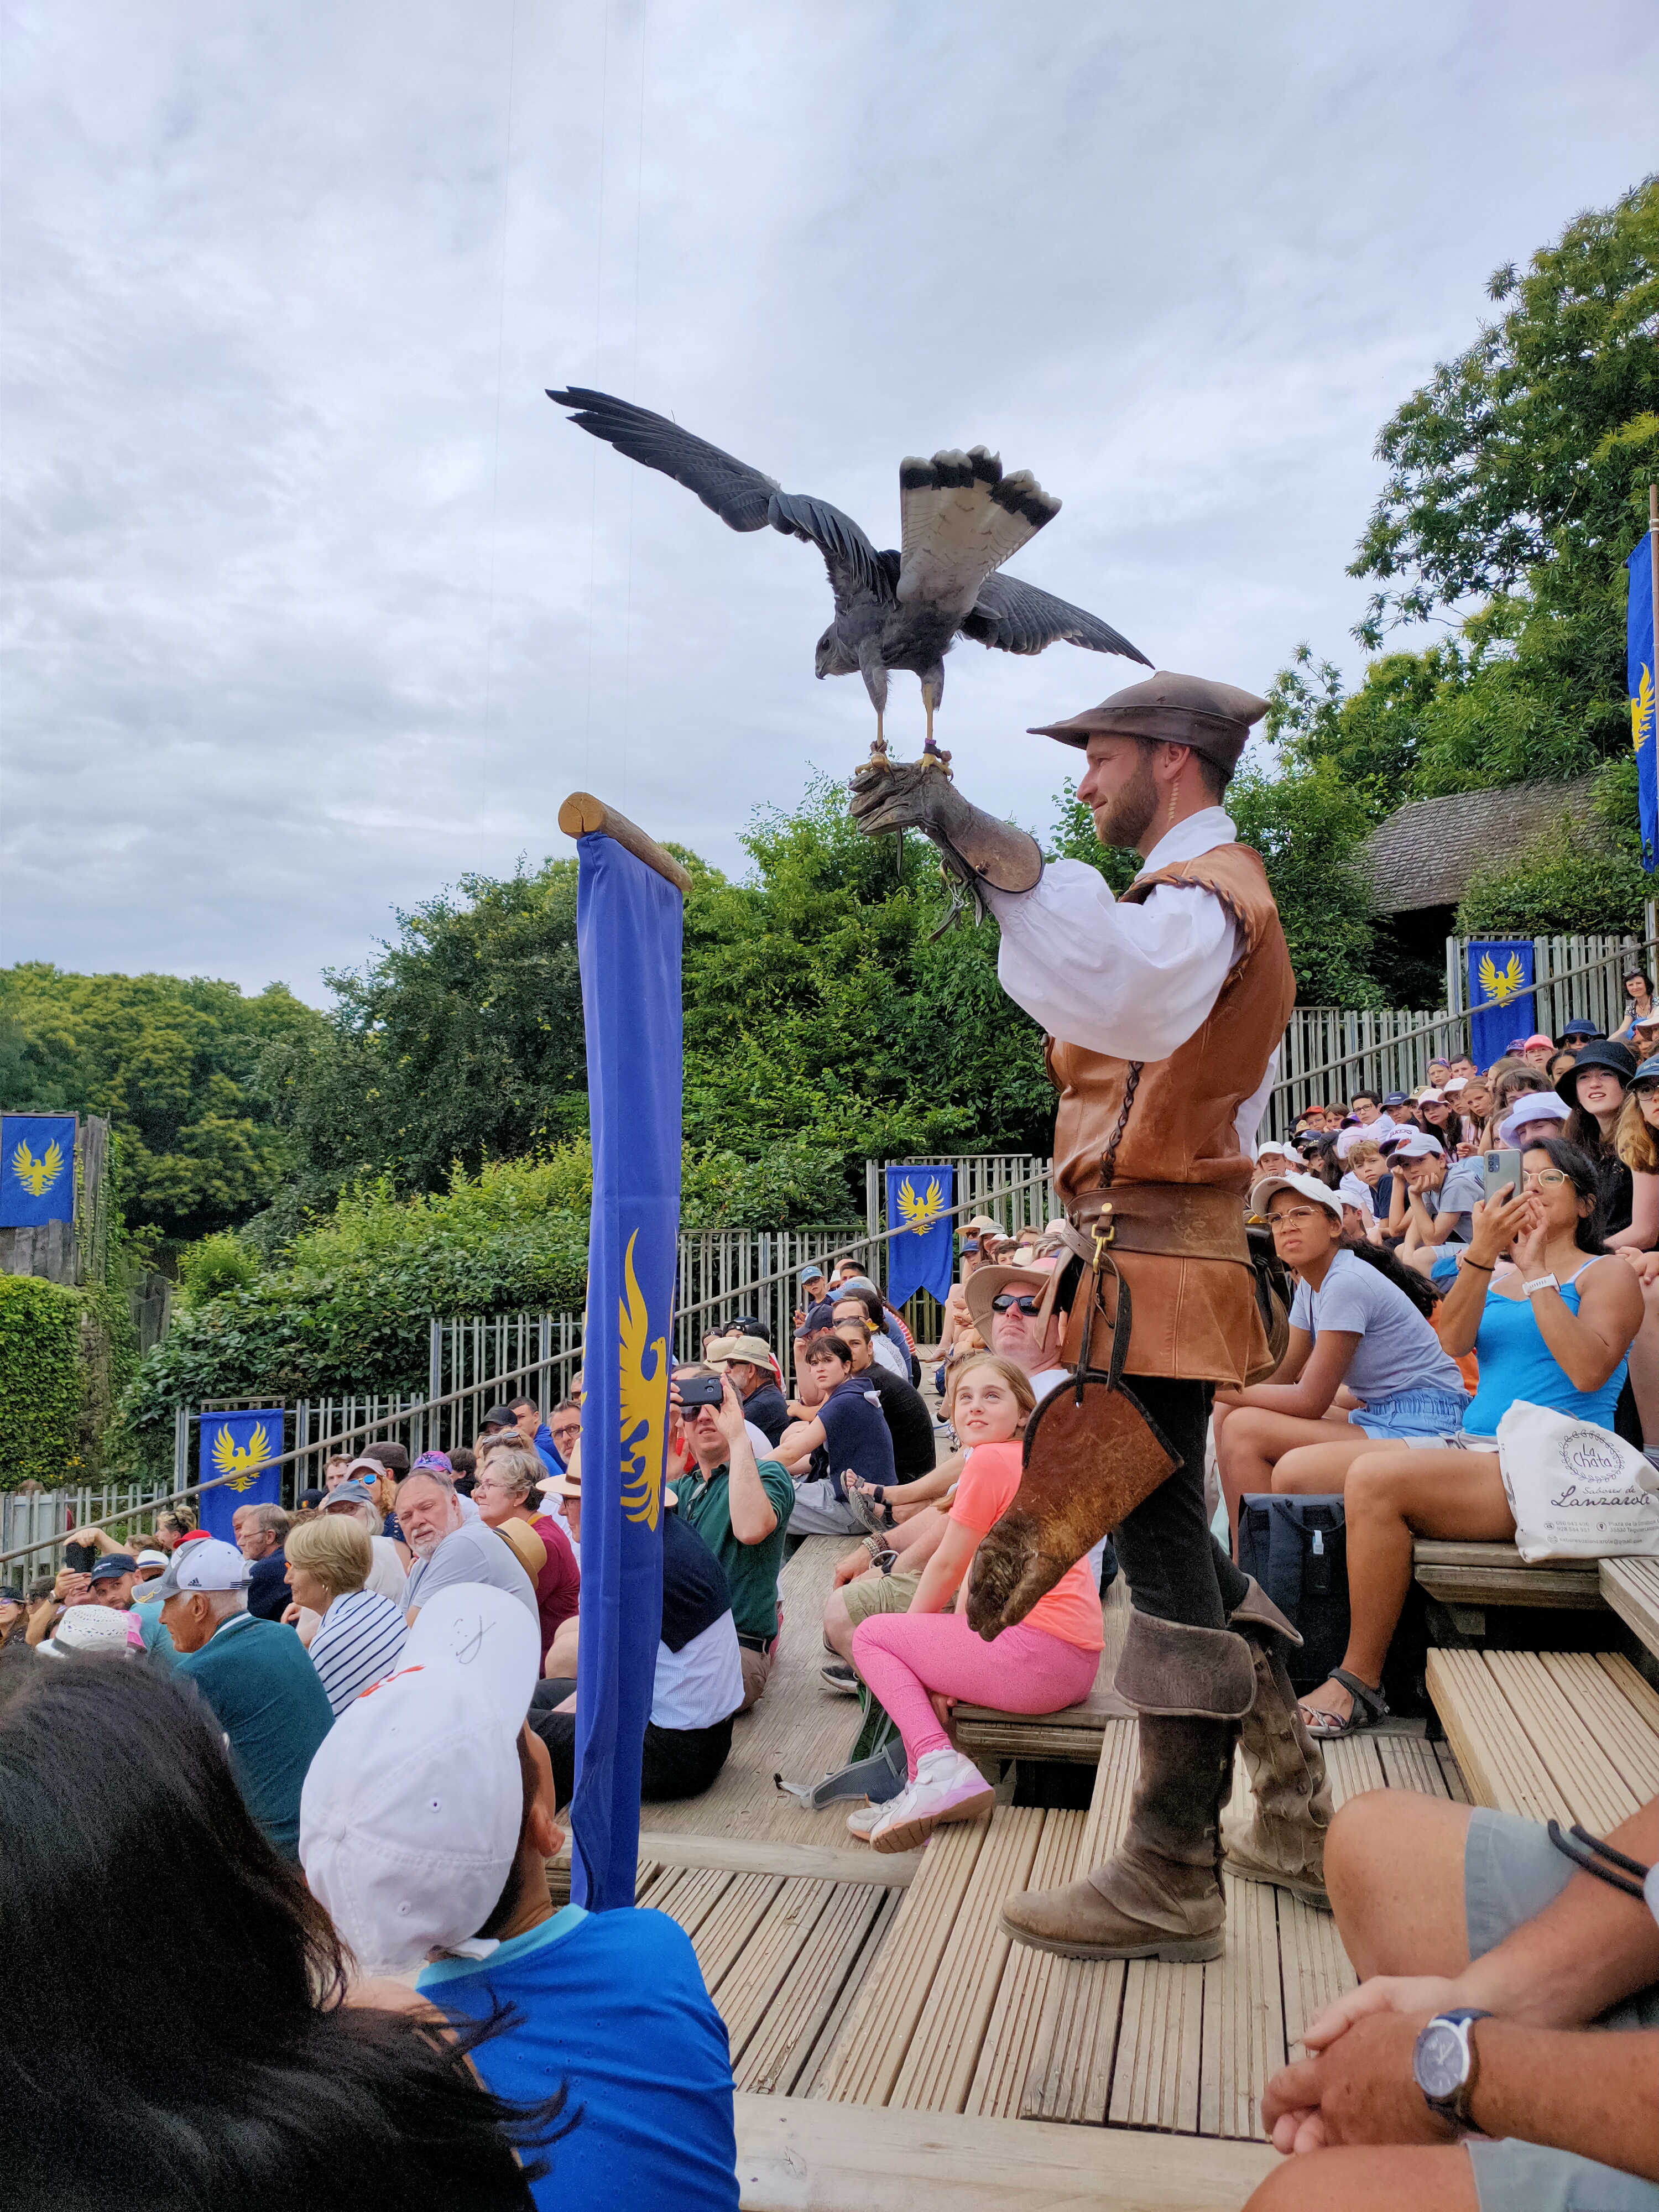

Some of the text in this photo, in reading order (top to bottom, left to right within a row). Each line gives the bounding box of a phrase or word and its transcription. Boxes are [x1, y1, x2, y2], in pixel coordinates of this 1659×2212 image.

[1583, 1443, 1595, 1457] La
[1573, 1451, 1612, 1468] Chata
[1551, 1485, 1650, 1507] Lanzarote
[1626, 1485, 1636, 1494] de
